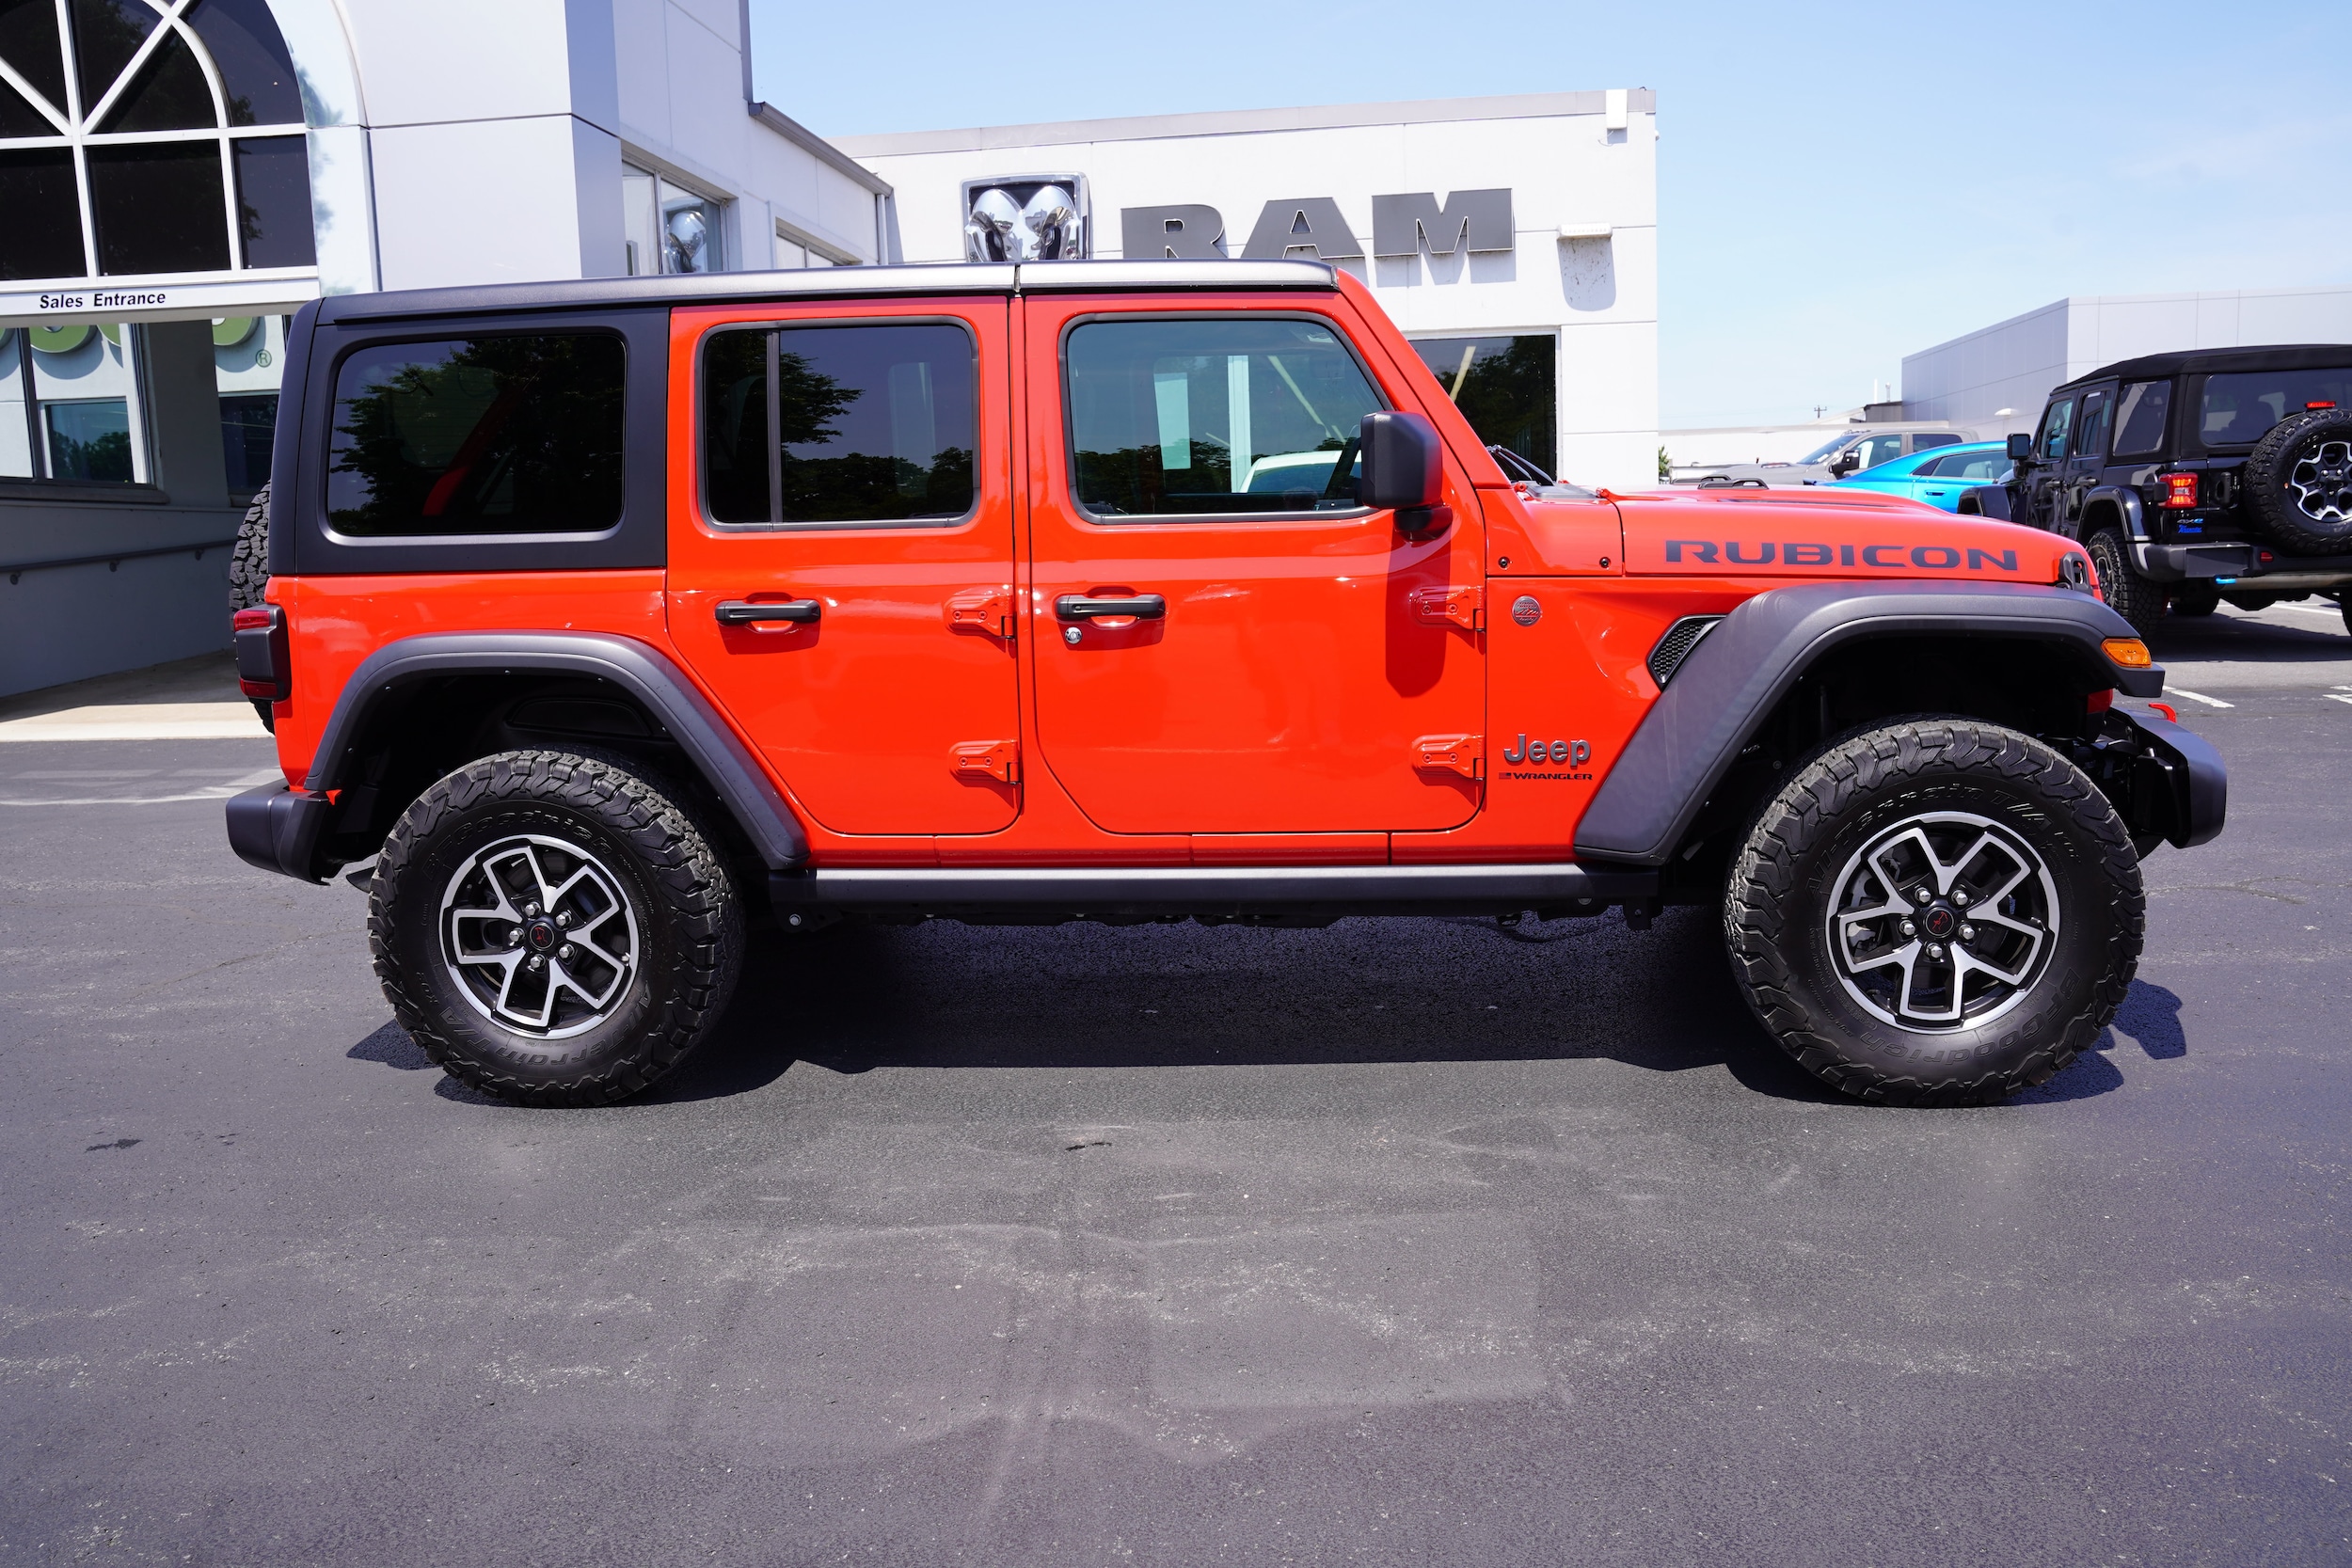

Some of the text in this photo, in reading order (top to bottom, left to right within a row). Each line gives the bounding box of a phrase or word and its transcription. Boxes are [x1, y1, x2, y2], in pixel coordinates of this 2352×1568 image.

[1120, 187, 1514, 260] RAM
[40, 292, 167, 309] Sales Entrance
[1665, 540, 2019, 572] RUBICON
[1503, 734, 1591, 767] Jeep
[1859, 968, 2082, 1067] BFGoodrich
